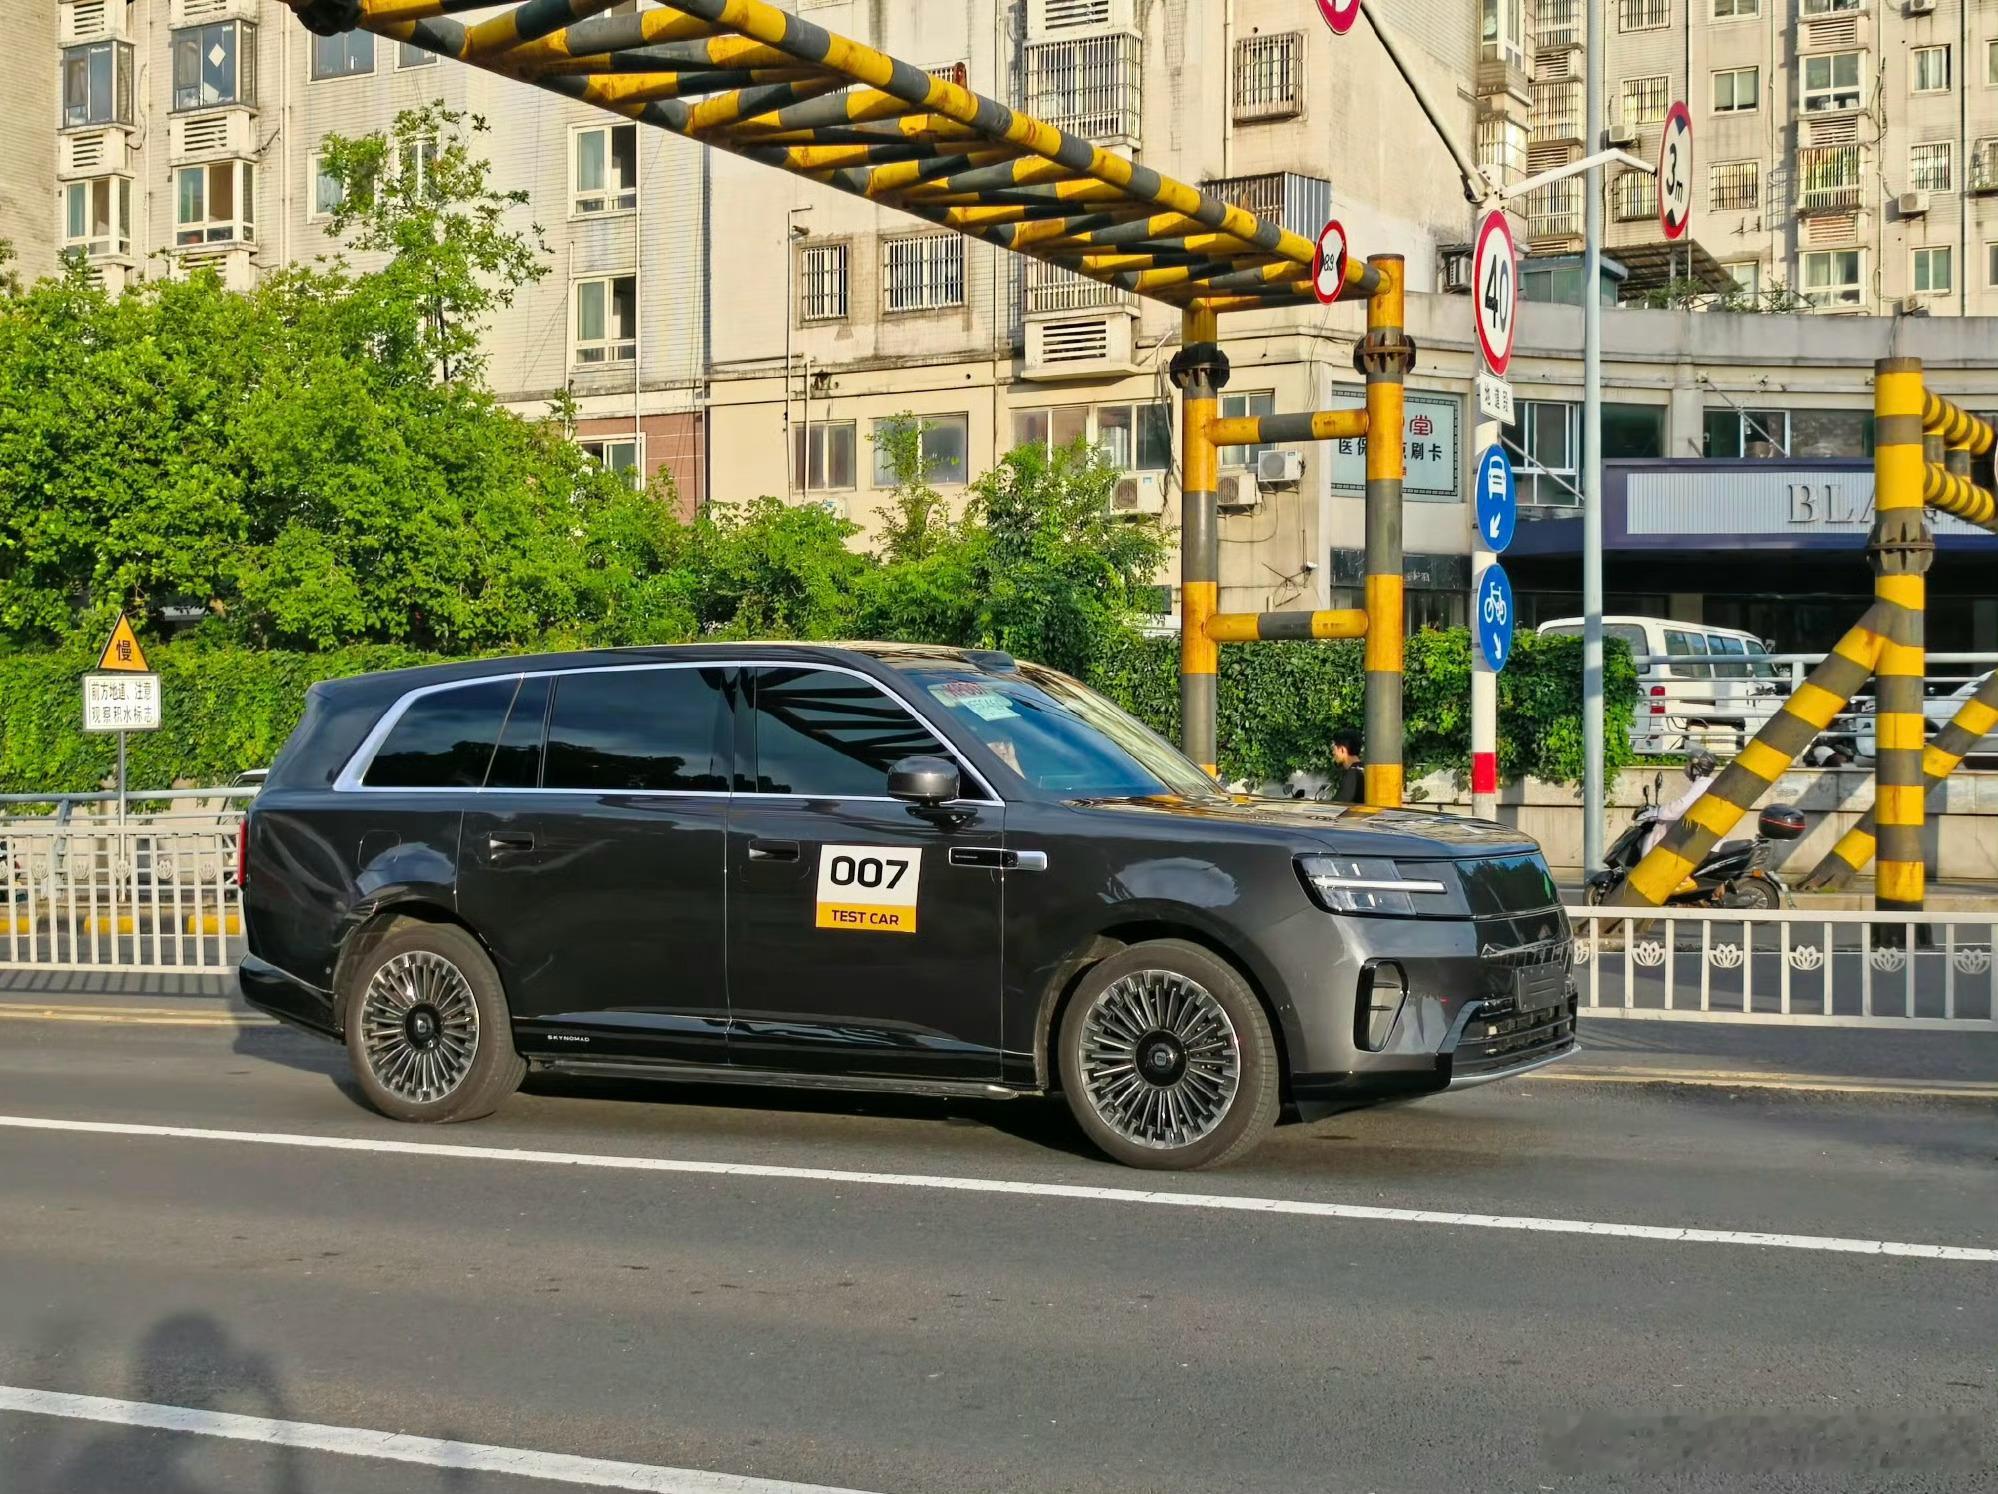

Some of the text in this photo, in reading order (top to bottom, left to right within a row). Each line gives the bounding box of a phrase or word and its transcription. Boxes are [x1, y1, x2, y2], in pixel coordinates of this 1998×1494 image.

[1485, 254, 1509, 333] 40
[116, 639, 132, 661] 慢
[92, 704, 152, 724] 观察积水标志
[831, 856, 909, 889] 007
[832, 910, 899, 925] TEST CAR
